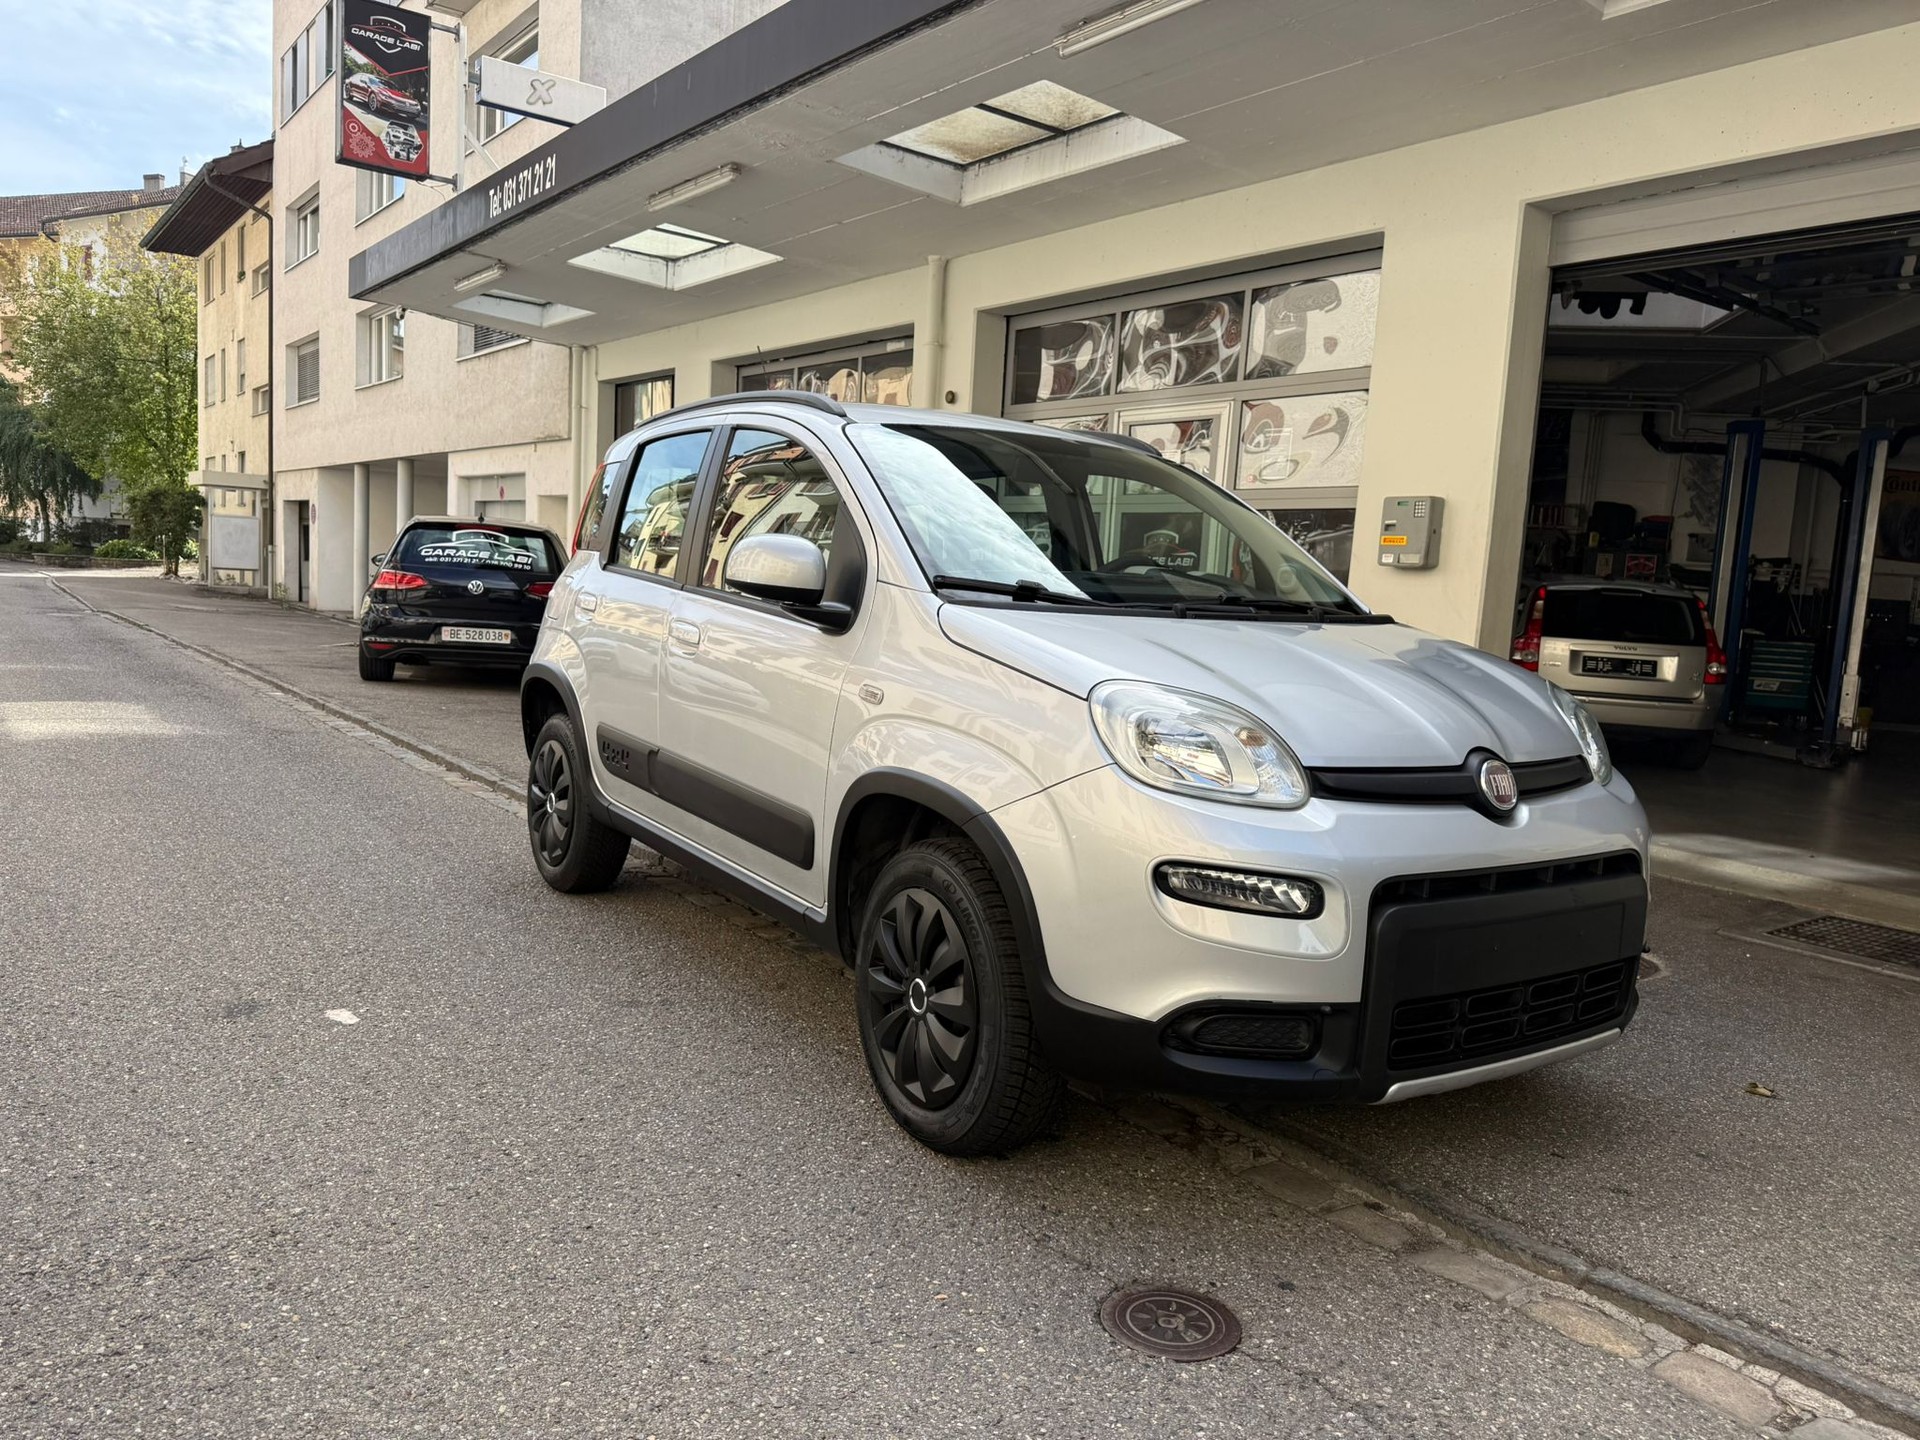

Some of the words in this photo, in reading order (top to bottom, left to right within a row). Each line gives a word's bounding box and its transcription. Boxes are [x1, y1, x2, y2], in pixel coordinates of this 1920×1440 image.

[351, 27, 396, 45] GARAGE
[396, 40, 421, 52] LABI
[503, 175, 517, 211] 031
[518, 166, 532, 204] 371
[533, 159, 544, 196] 21
[545, 153, 556, 190] 21
[420, 548, 491, 559] GARAGE
[493, 552, 533, 565] LABI
[1167, 557, 1194, 567] LABI
[1489, 773, 1513, 797] FIAT
